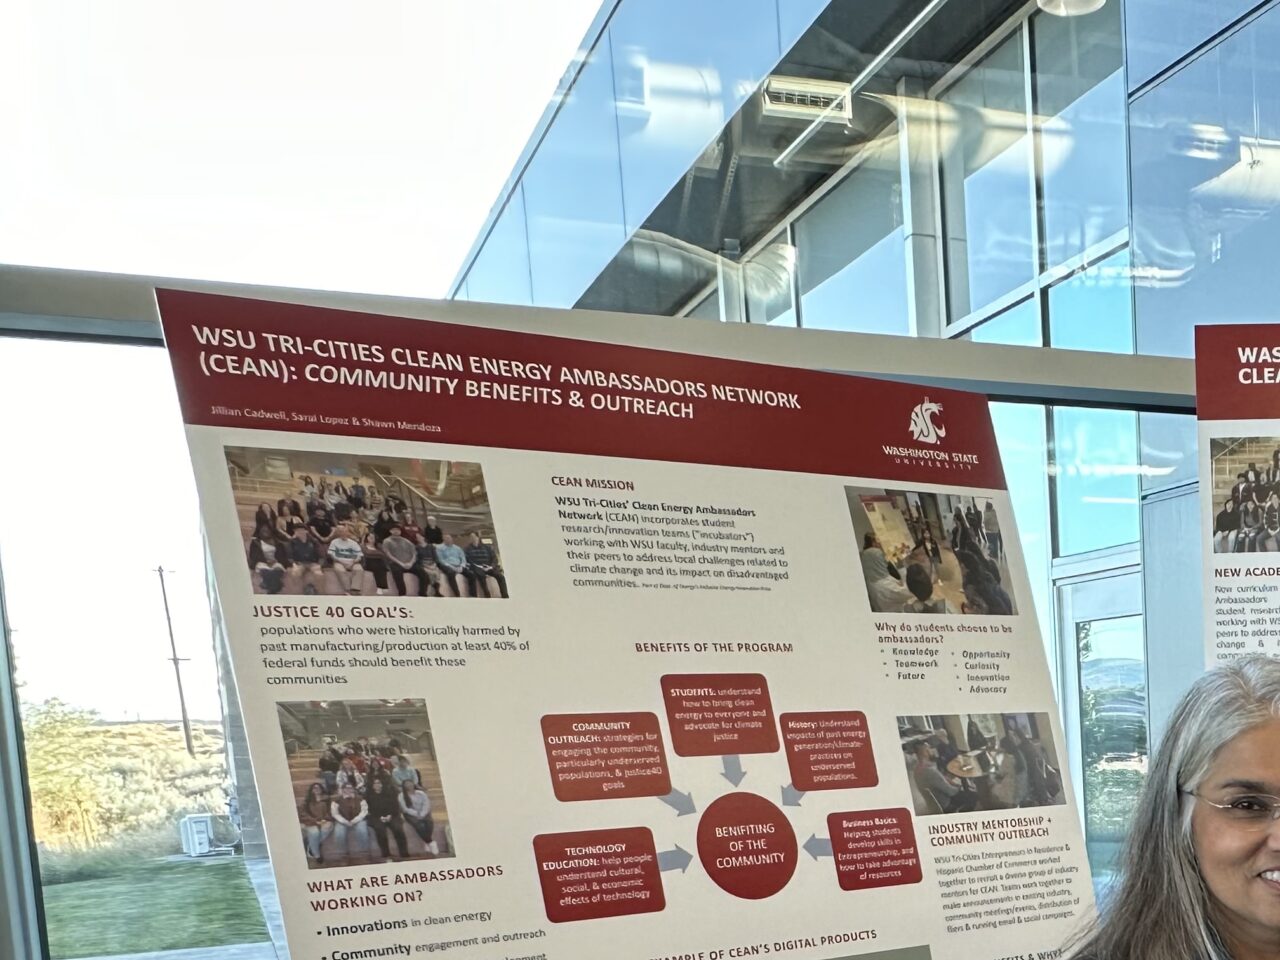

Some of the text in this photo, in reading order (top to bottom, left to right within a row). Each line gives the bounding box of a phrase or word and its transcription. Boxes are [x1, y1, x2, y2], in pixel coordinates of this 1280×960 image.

[190, 324, 802, 409] WSU TRI-CITIES CLEAN ENERGY AMBASSADORS NETWORK
[198, 350, 694, 419] (CEAN): COMMUNITY BENEFITS & OUTREACH
[881, 444, 950, 461] WASHINGTON
[894, 457, 972, 471] UNIVERSITY
[550, 475, 635, 492] CEAN MISSION
[1214, 567, 1242, 578] NEW
[252, 604, 320, 618] JUSTICE
[324, 605, 345, 618] 40
[259, 623, 521, 638] populations who were historically harmed by
[634, 641, 794, 653] BENEFITS OF THE PROGRAM
[714, 822, 775, 838] BENIFITING
[927, 820, 978, 835] INDUSTRY
[980, 815, 1045, 830] MENTORSHIP
[728, 837, 768, 852] OF THE
[929, 826, 1050, 847] COMMUNITY OUTREACH
[715, 851, 785, 869] COMMUNITY
[305, 864, 504, 893] WHAT ARE AMBASSADORS
[309, 889, 423, 912] WORKING ON?
[325, 911, 492, 937] Innovations in clean energy
[414, 936, 479, 953] engagement
[480, 933, 501, 945] and
[501, 928, 546, 942] outreach
[708, 948, 725, 960] OF
[728, 942, 771, 958] CEAN'S
[772, 937, 818, 952] DIGITAL
[819, 928, 877, 946] PRODUCTS
